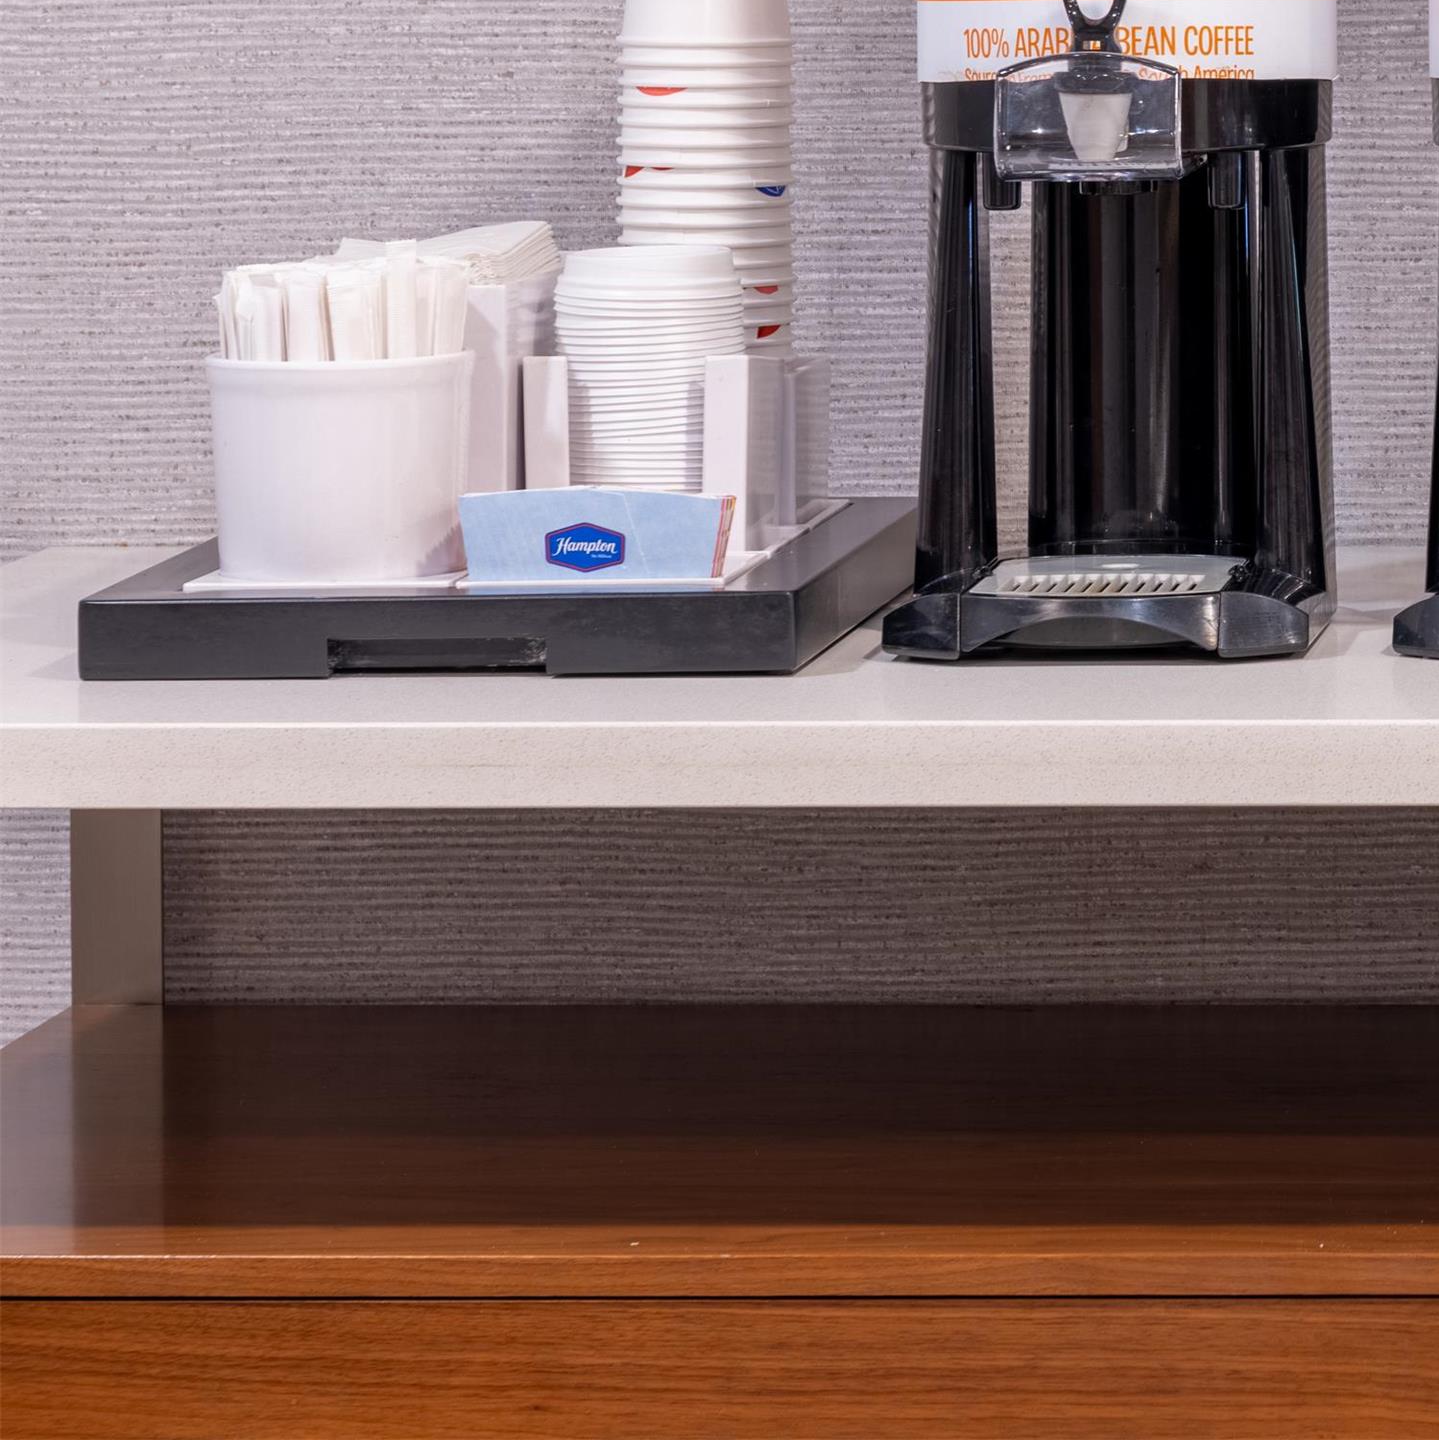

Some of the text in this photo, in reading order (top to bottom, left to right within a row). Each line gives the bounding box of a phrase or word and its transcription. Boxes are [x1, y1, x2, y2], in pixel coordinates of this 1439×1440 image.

[963, 27, 1009, 58] 100%
[1118, 25, 1176, 56] BEAN
[1183, 25, 1255, 56] COFFEE
[552, 536, 618, 556] Hampton
